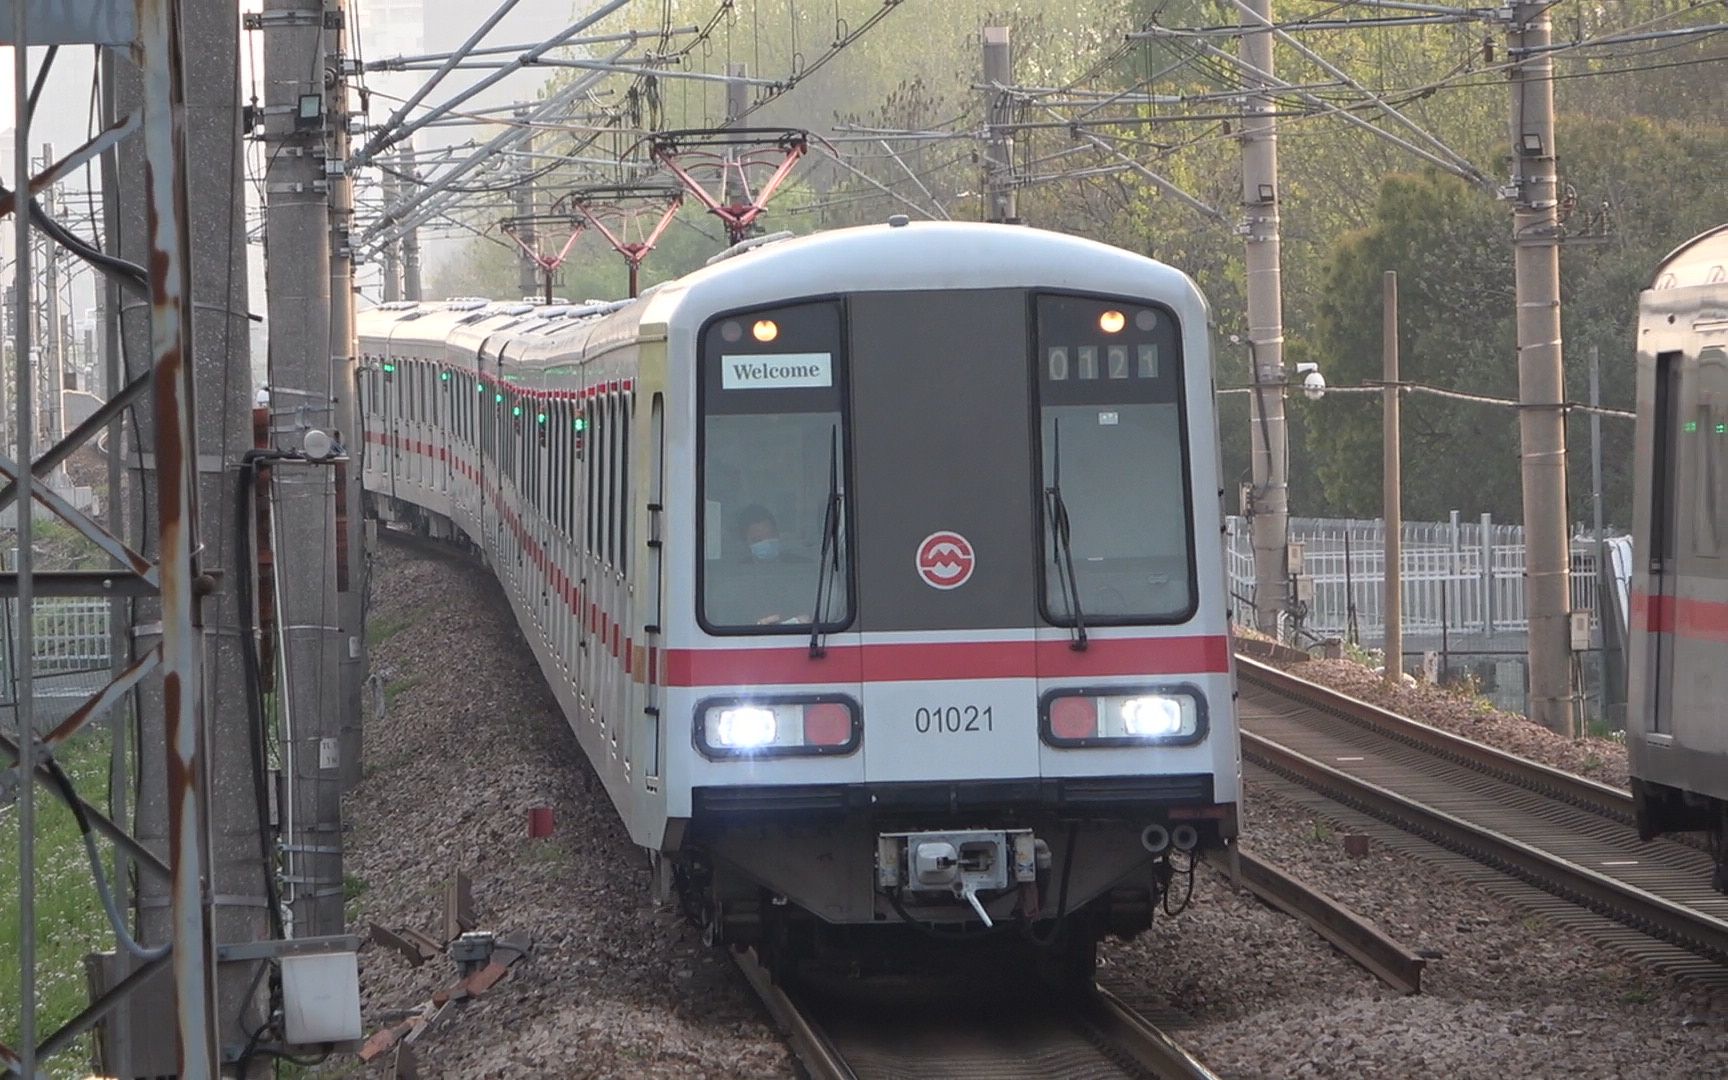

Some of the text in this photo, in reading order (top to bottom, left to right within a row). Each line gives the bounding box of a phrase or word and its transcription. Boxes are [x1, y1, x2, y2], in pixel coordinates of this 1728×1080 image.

[733, 363, 820, 381] Welcome
[1049, 349, 1156, 380] 0121
[915, 705, 993, 733] 01021
